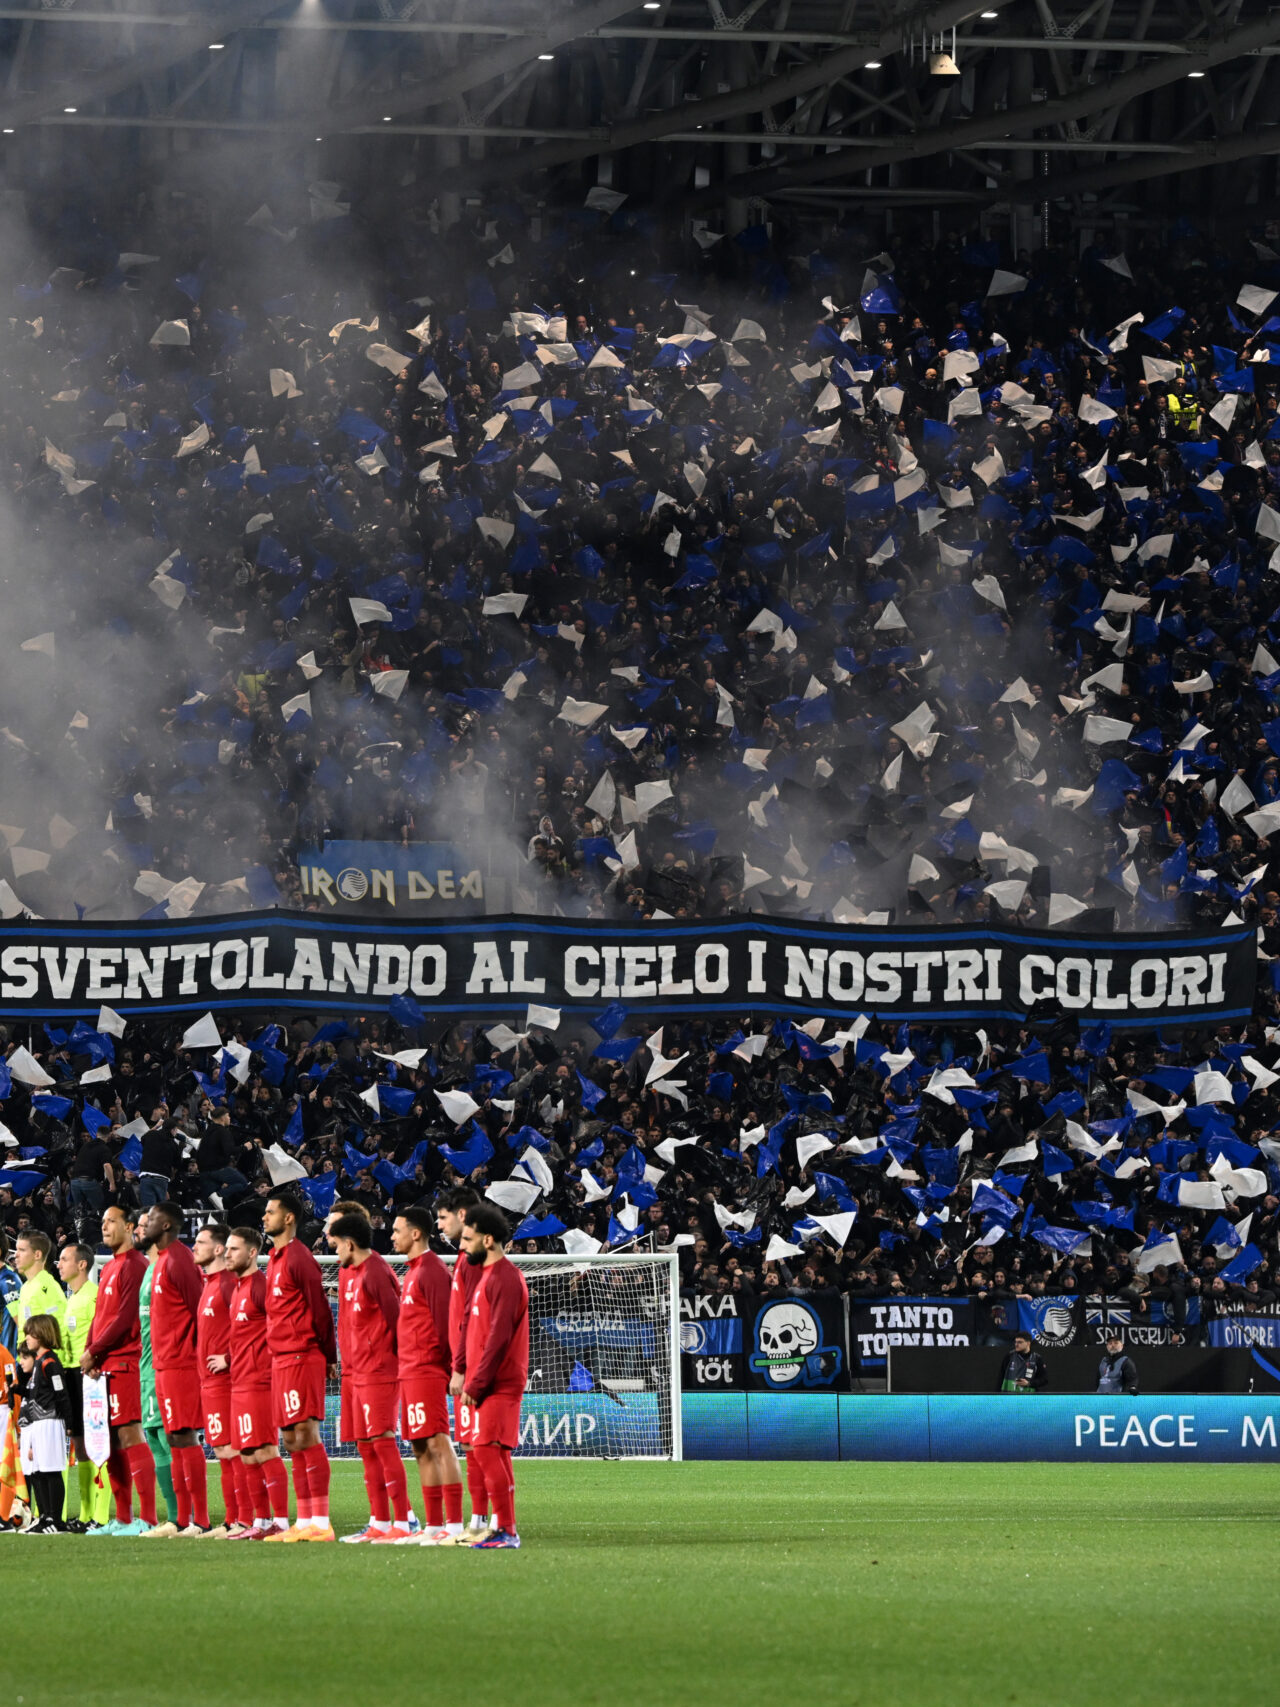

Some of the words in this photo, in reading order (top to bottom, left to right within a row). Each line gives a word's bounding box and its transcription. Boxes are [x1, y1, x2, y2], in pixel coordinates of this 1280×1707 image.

[1, 936, 447, 999] SVENTOLANDO
[465, 940, 546, 994] AL
[564, 943, 729, 998] CIELO
[748, 940, 767, 993] I
[785, 946, 1002, 1002] NOSTRI
[1022, 952, 1228, 1009] COLORI
[870, 1306, 953, 1330] TANTO
[1031, 1326, 1077, 1348] CONFUSIONE
[695, 1358, 733, 1383] töt
[109, 1394, 120, 1414] 4
[164, 1398, 172, 1419] 5
[284, 1390, 301, 1413] 18
[207, 1413, 222, 1434] 26
[238, 1413, 252, 1436] 10
[407, 1402, 427, 1426] 66
[460, 1405, 470, 1428] 8
[1075, 1414, 1198, 1447] PEACE
